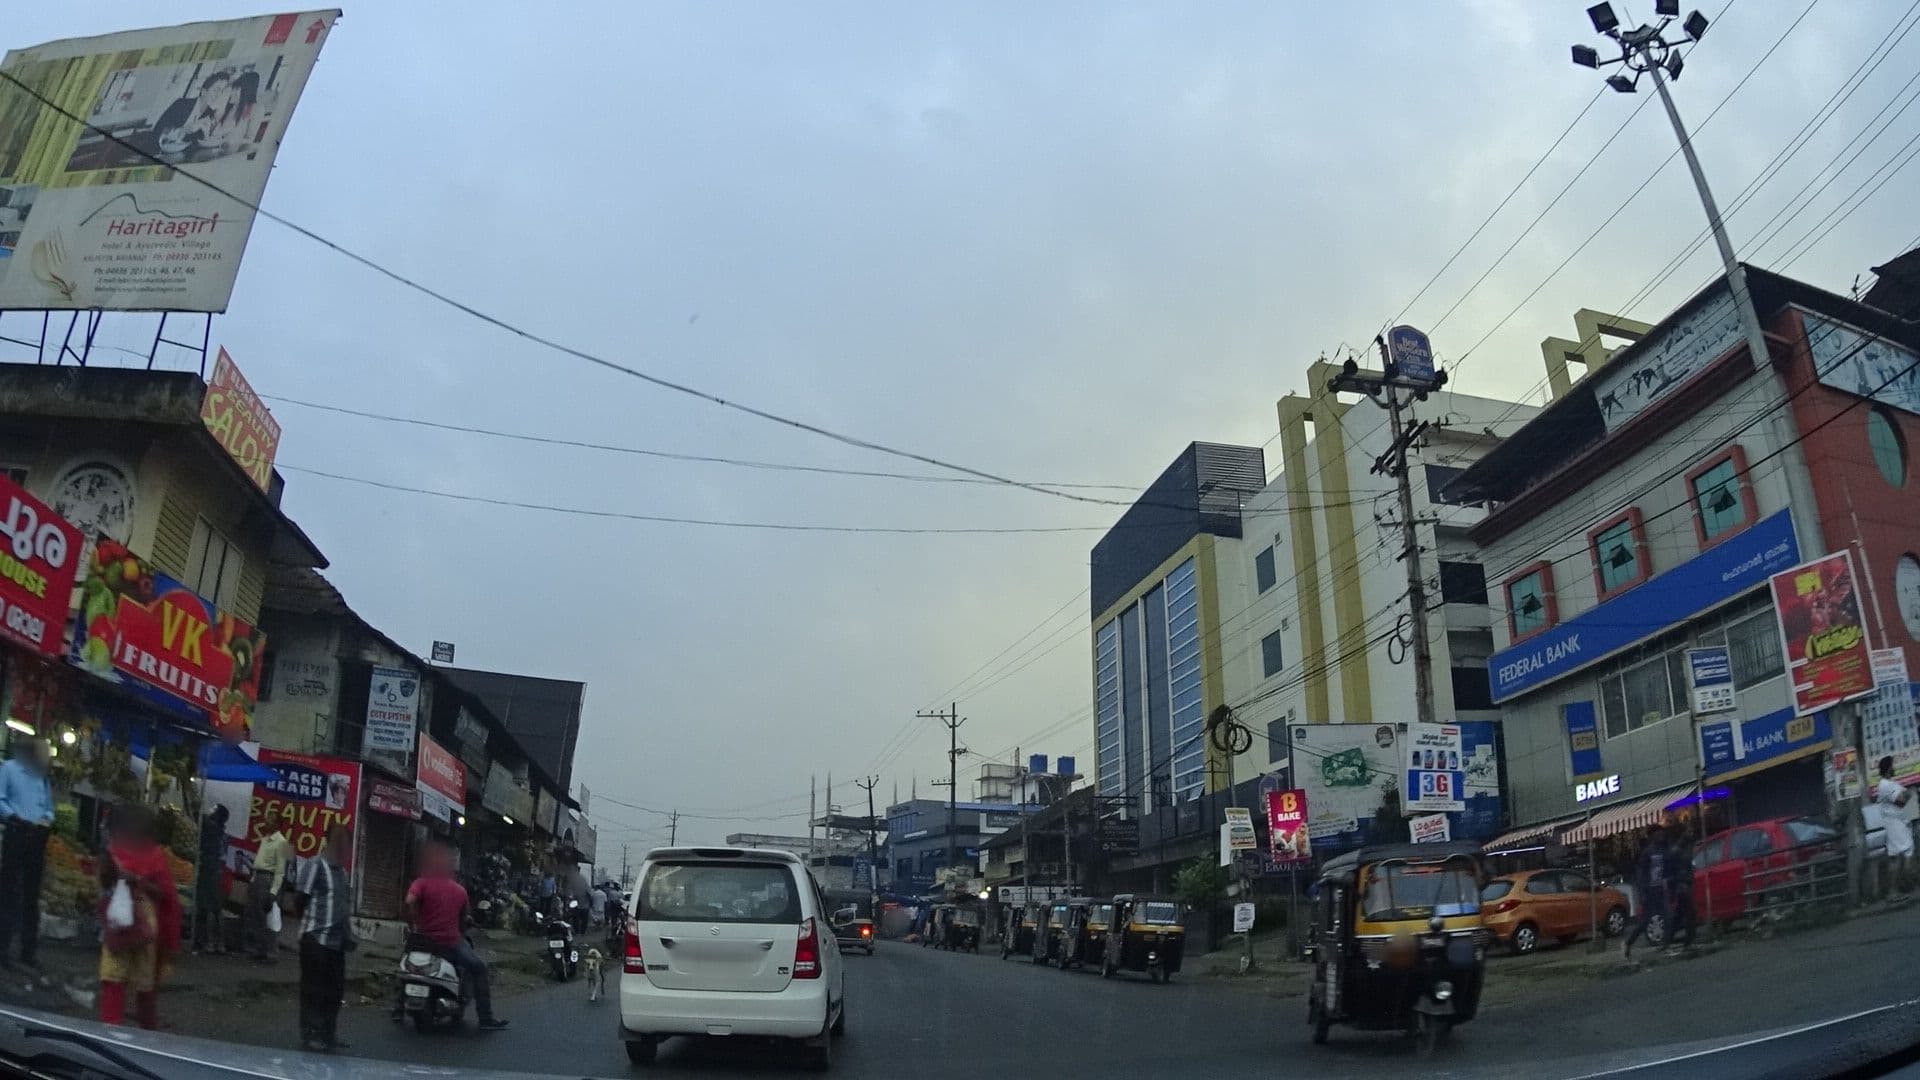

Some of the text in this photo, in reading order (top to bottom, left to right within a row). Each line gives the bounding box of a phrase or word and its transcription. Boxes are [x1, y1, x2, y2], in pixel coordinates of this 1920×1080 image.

[107, 212, 219, 238] Haritagiri
[202, 393, 273, 495] SALON
[162, 599, 208, 668] VK
[1499, 651, 1545, 685] FEDERAL
[1546, 633, 1581, 664] BANK
[122, 642, 219, 705] FRUITS
[1755, 730, 1785, 750] BANK
[266, 780, 322, 798] BEARD
[1422, 774, 1449, 793] 3G
[1575, 774, 1620, 802] BAKE
[1280, 792, 1298, 812] B
[1277, 811, 1302, 822] BAKE
